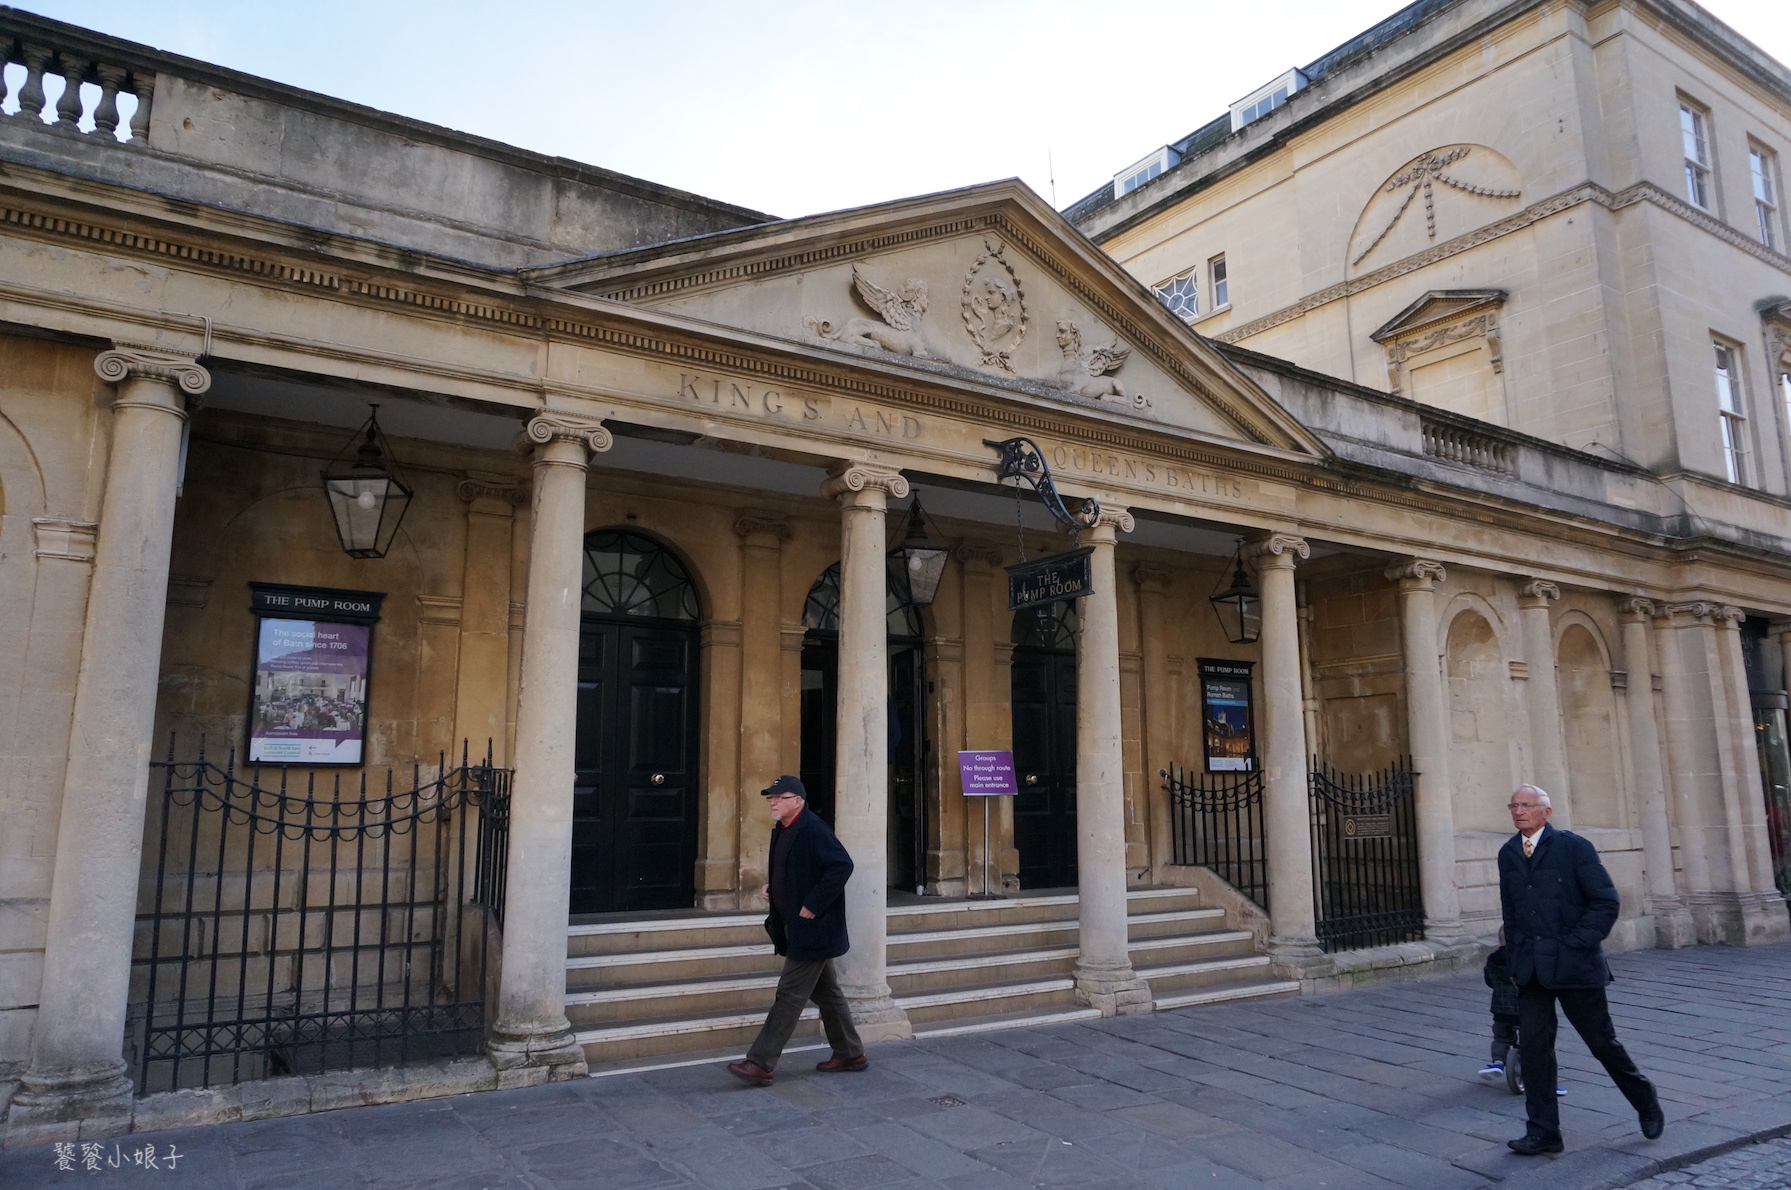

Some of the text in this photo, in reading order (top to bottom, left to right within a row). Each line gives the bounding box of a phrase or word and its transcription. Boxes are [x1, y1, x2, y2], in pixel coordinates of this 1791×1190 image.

[848, 407, 922, 439] AND
[1166, 467, 1241, 499] BATHS
[1037, 571, 1058, 586] THE
[1017, 579, 1081, 604] PUMP ROOM
[264, 595, 371, 612] THE PUMP ROOM
[273, 628, 340, 640] The social heart
[304, 640, 328, 649] since
[329, 641, 348, 650] 1706
[1203, 665, 1249, 675] THE PUMP ROOM
[1206, 684, 1220, 692] Pump
[974, 754, 997, 762] Groups
[973, 764, 996, 773] through
